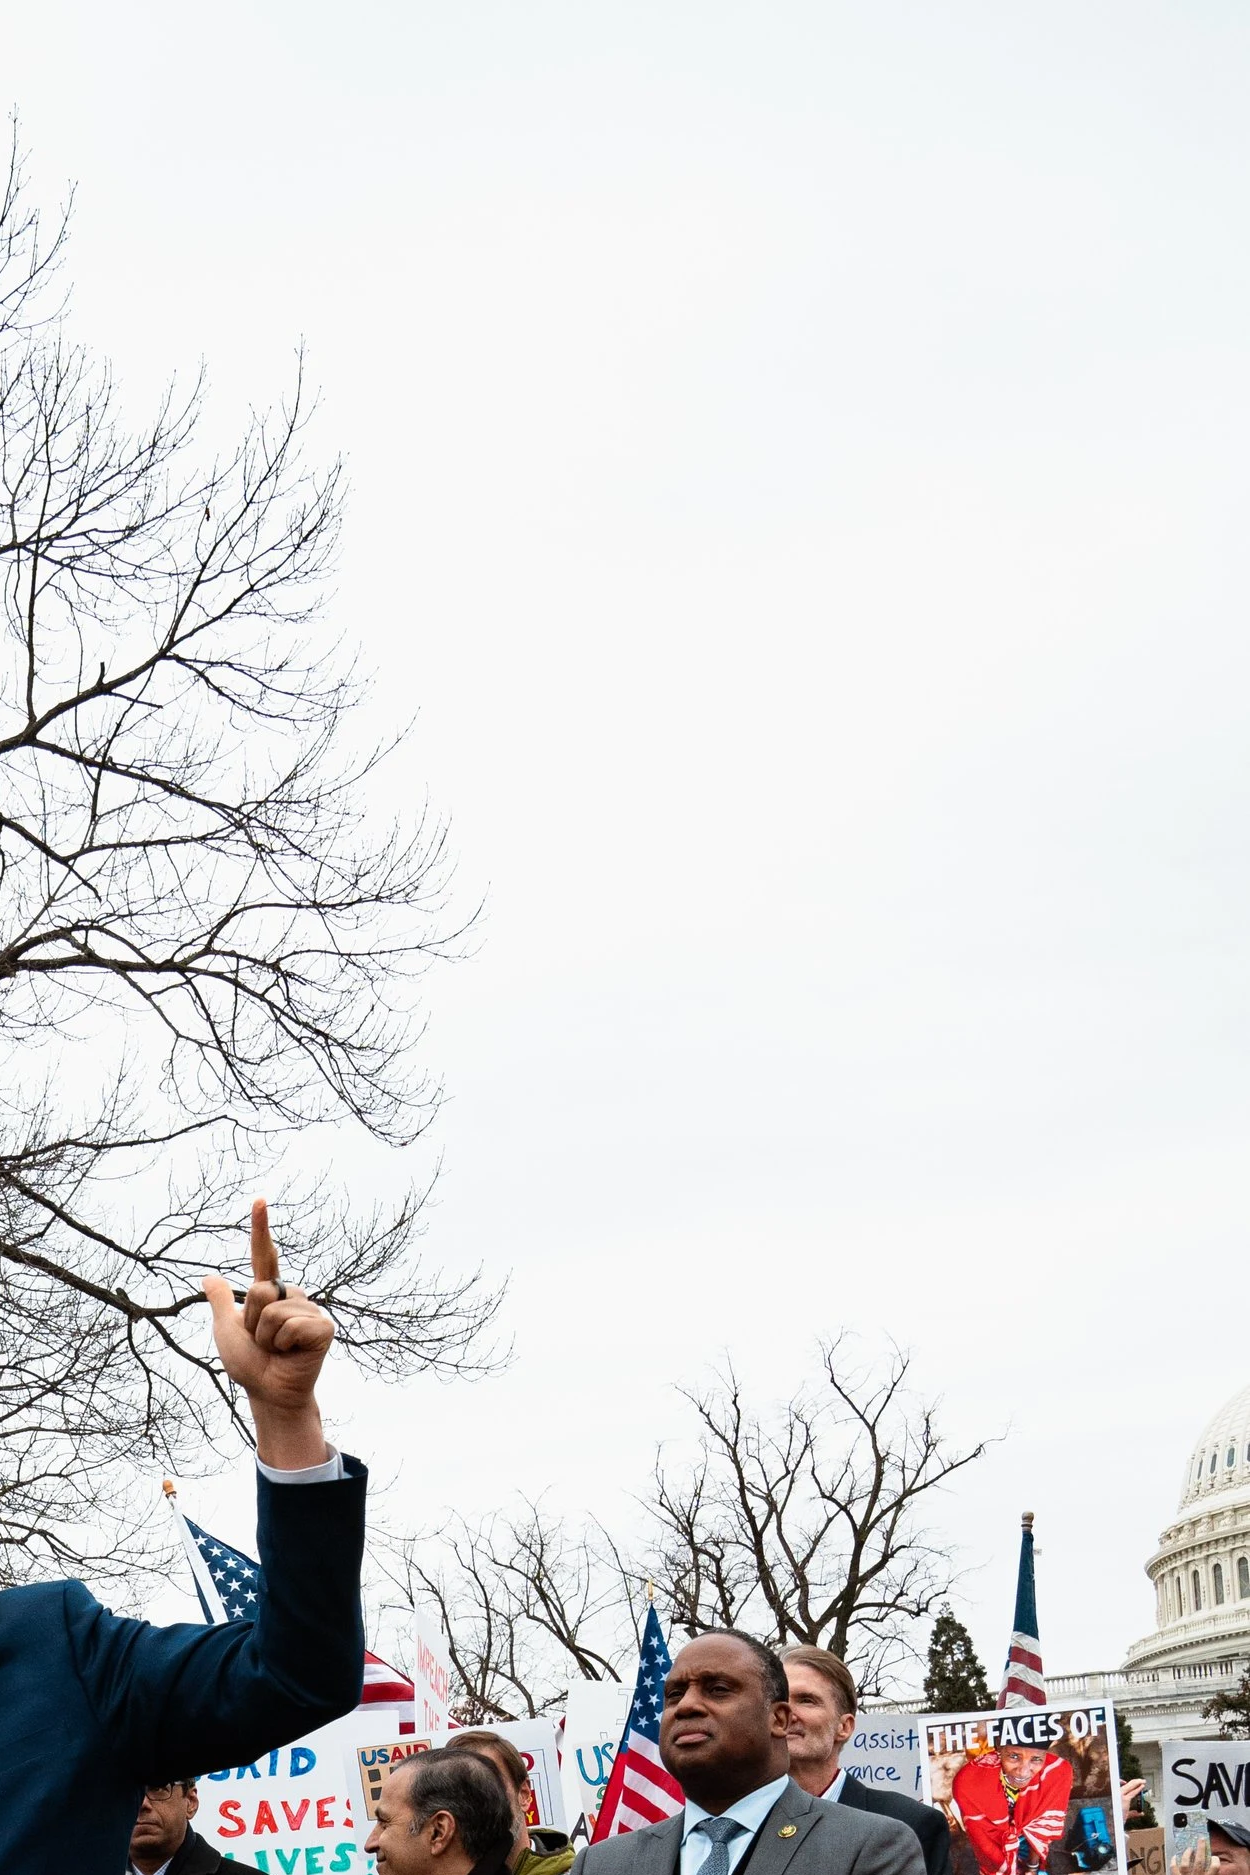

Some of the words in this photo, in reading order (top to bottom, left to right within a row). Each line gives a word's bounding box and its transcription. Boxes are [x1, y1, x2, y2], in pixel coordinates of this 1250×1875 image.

[417, 1634, 449, 1706] IMPEACH
[854, 1728, 920, 1751] assist
[928, 1723, 979, 1753] THE
[986, 1713, 1064, 1750] FACES
[1070, 1709, 1107, 1738] OF
[194, 1746, 317, 1782] AID
[1171, 1758, 1250, 1810] SAV
